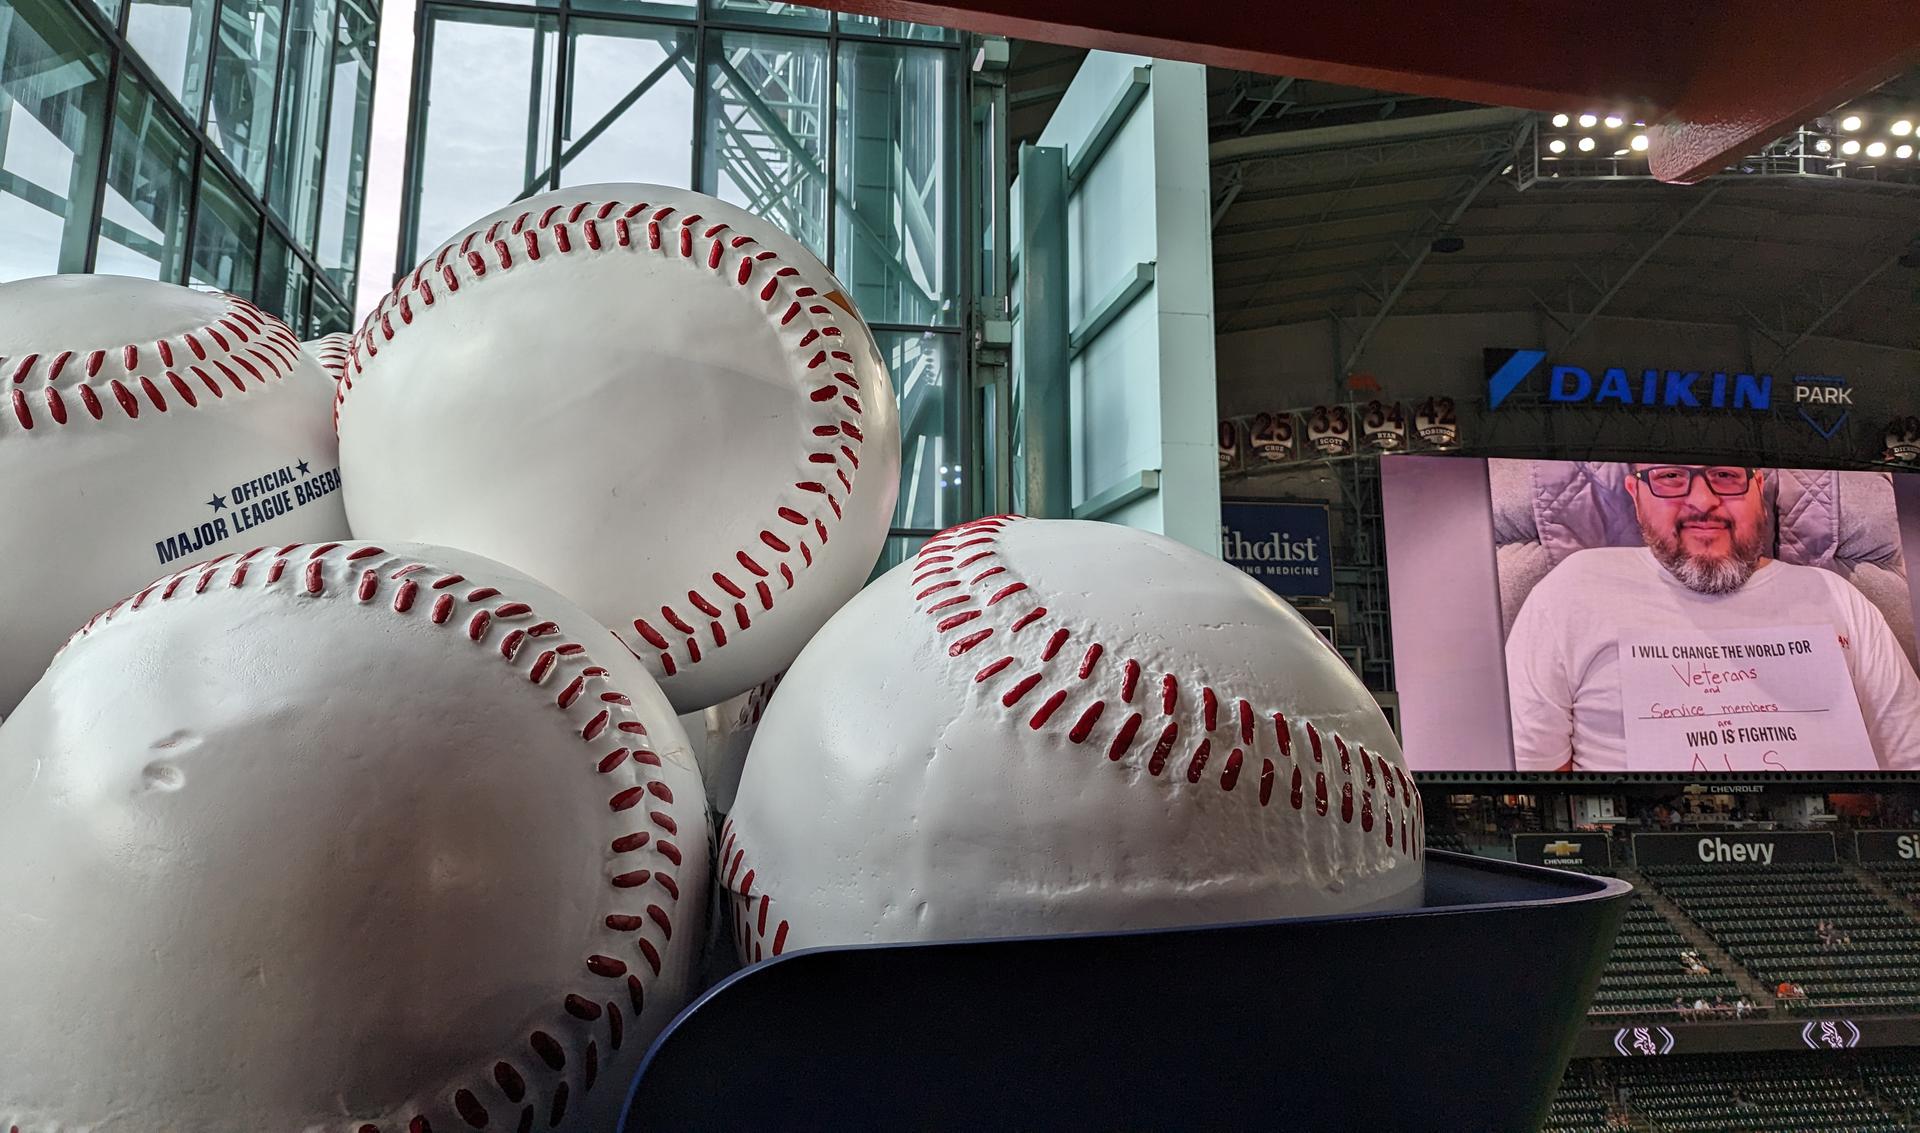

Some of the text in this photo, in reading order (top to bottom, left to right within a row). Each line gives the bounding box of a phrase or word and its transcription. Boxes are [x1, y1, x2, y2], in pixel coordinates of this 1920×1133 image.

[1550, 365, 1854, 411] DAIKIN PARK
[1312, 405, 1349, 435] 33
[1367, 400, 1405, 429] 34
[1416, 396, 1457, 425] 42
[1256, 412, 1293, 441] 25
[1319, 438, 1343, 446] SCOTT
[230, 466, 297, 506] OFFICIAL
[155, 517, 230, 565] MAJOR
[231, 490, 294, 534] LEAGUE
[1266, 566, 1319, 576] MEDICINE
[1639, 645, 1670, 659] WILL
[1671, 645, 1721, 660] CHANGE
[1721, 645, 1744, 659] THE
[1744, 643, 1786, 659] WORLD
[1788, 640, 1813, 656] FOR
[1671, 662, 1758, 687] Veterans
[1703, 685, 1721, 694] and
[1651, 701, 1779, 719] Service members
[1686, 726, 1798, 748] WHO IS FIGHTING
[1710, 785, 1765, 793] CHEVROLET
[1697, 837, 1775, 866] Chevy
